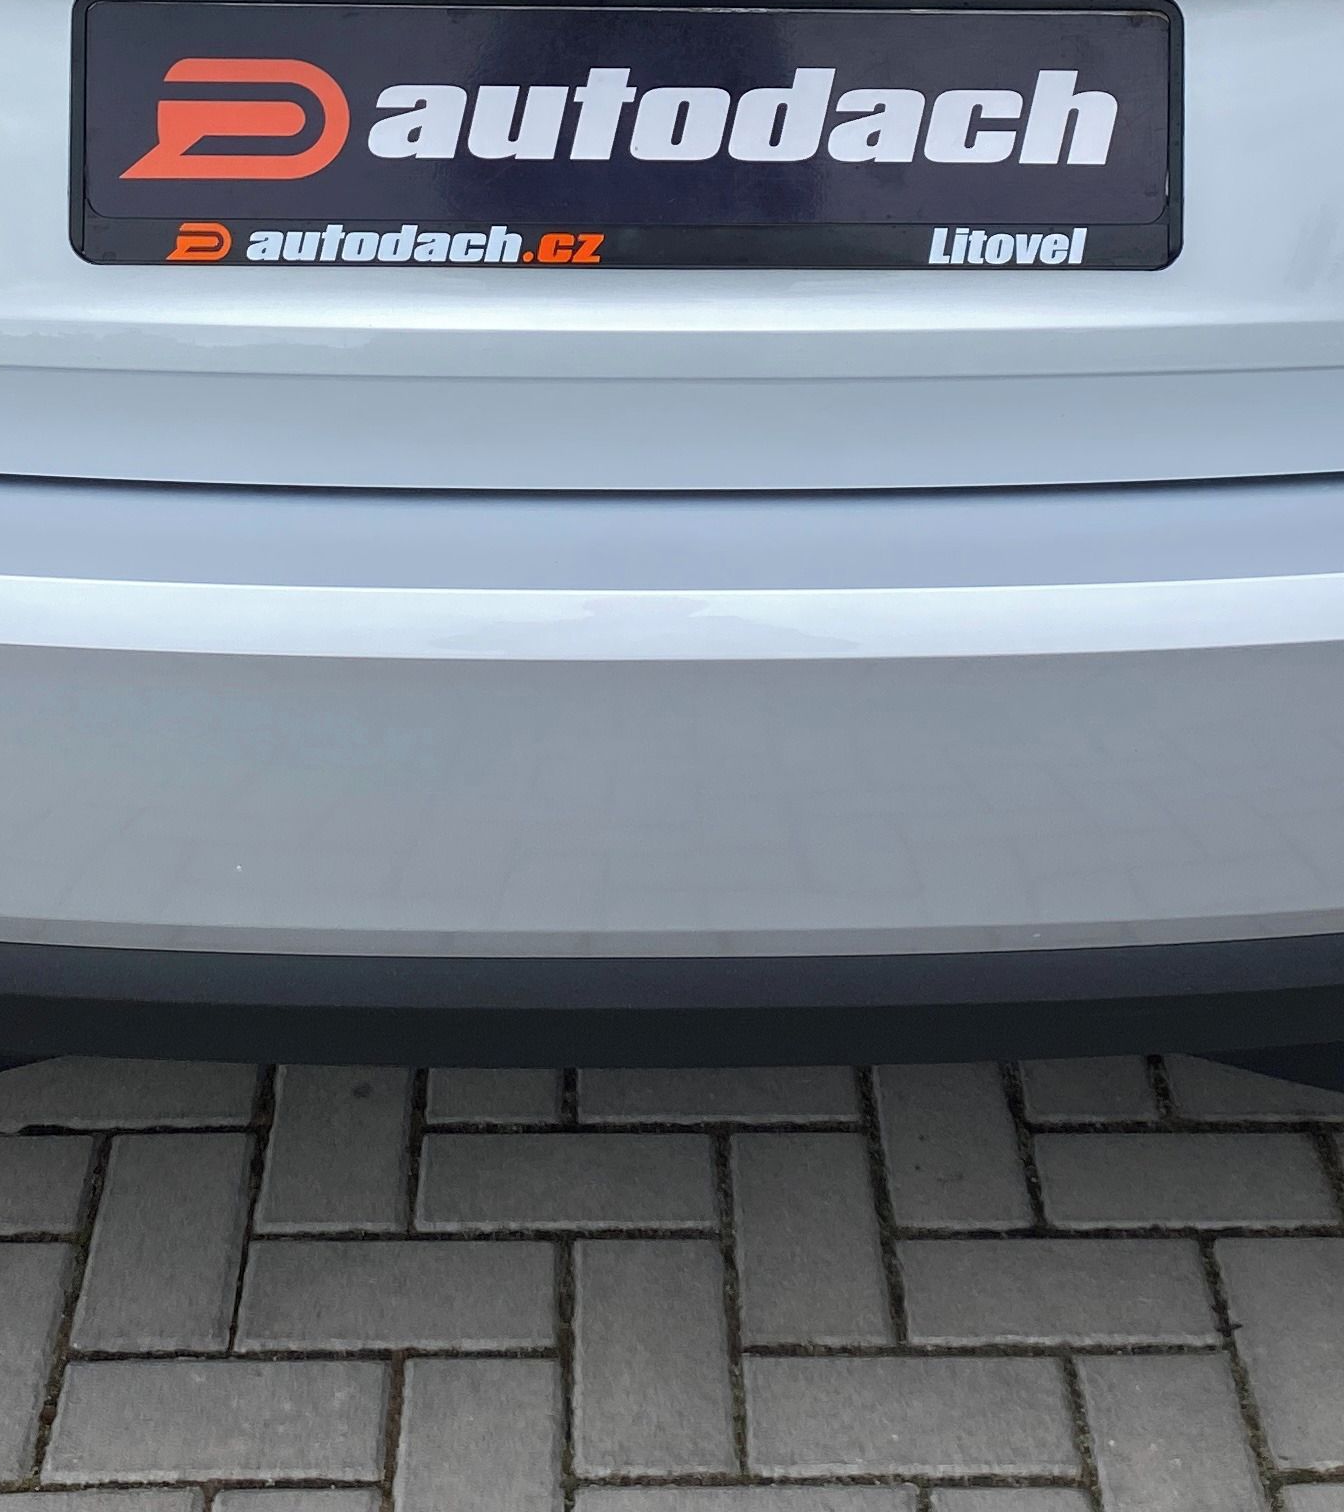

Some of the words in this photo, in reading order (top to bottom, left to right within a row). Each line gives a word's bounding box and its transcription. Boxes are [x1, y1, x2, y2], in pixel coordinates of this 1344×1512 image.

[367, 67, 1118, 165] autodach
[246, 224, 605, 264] autodach.cz
[928, 227, 1088, 265] Litovel
